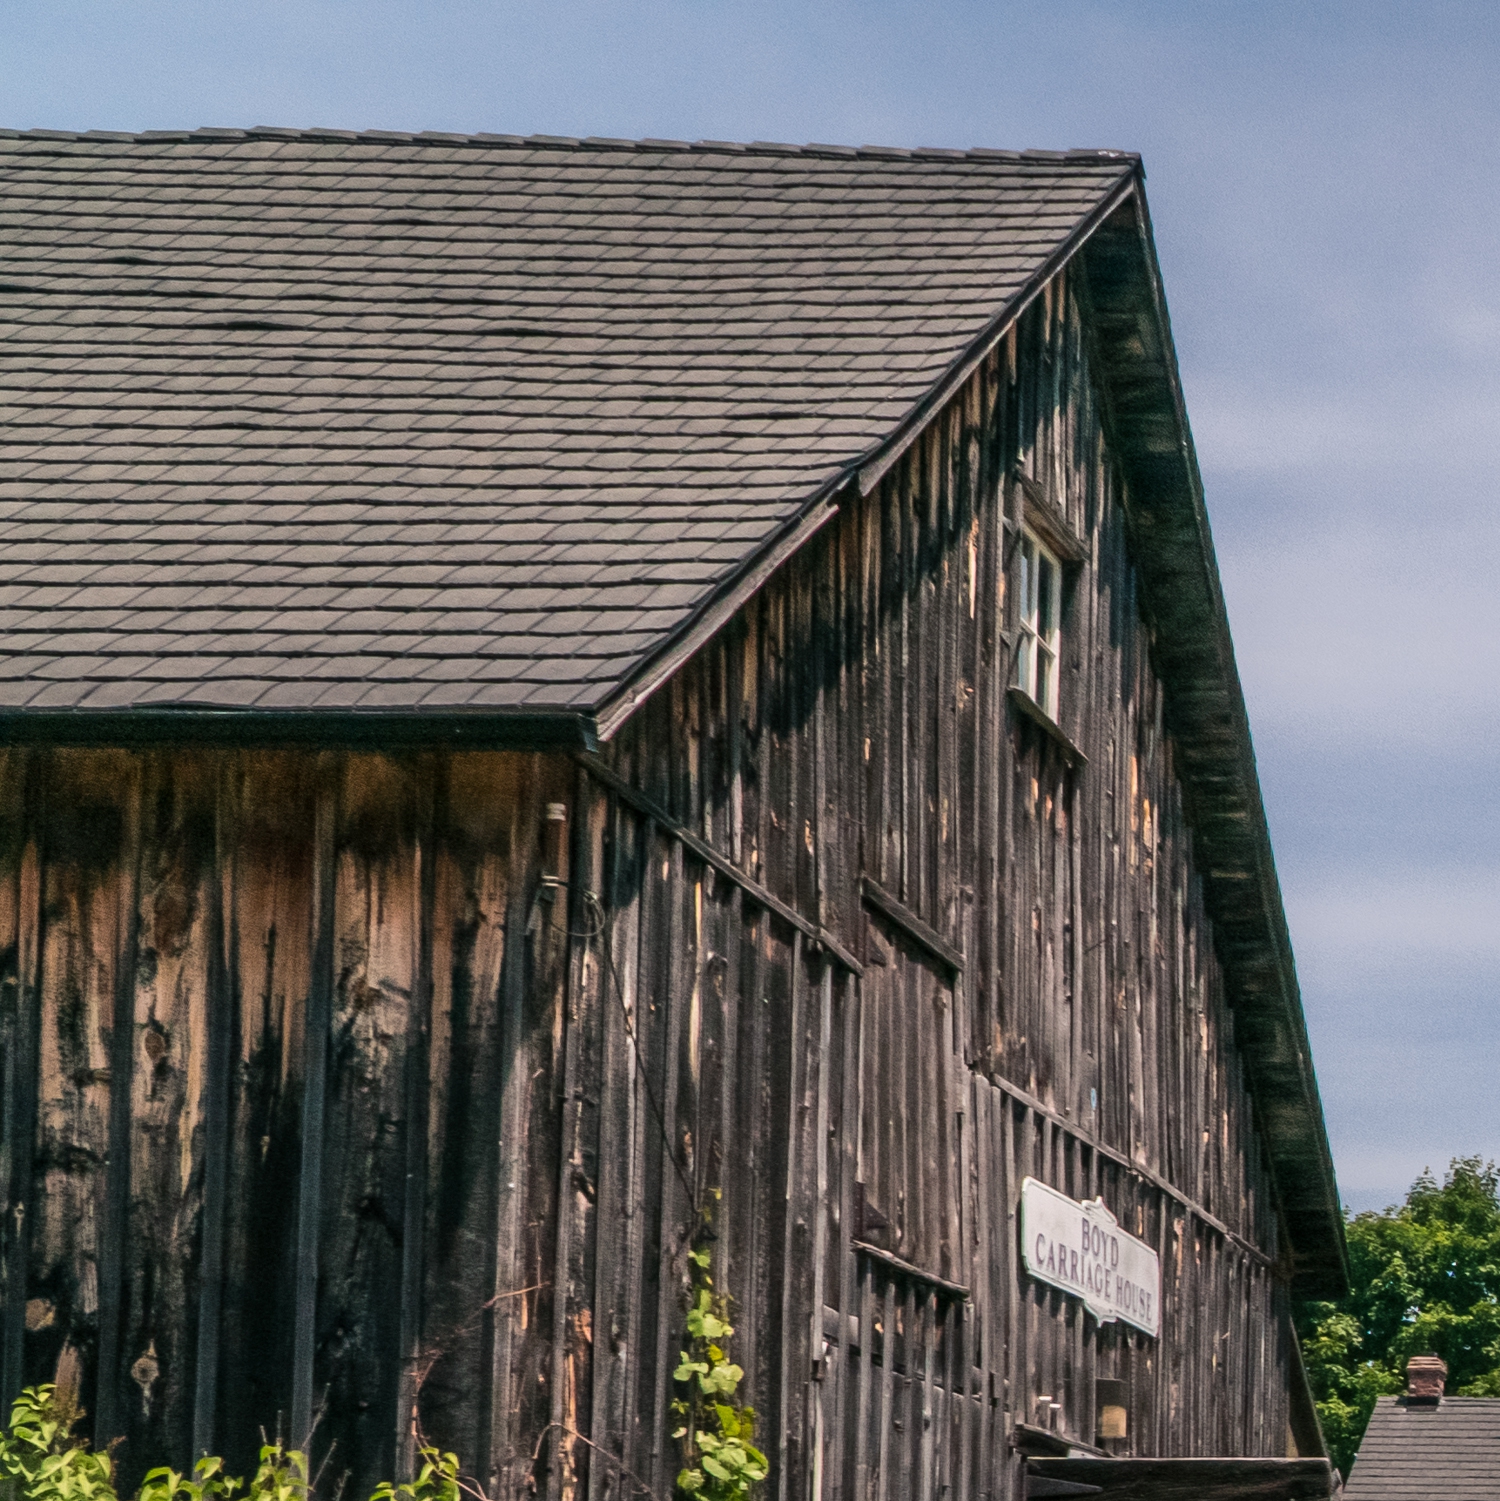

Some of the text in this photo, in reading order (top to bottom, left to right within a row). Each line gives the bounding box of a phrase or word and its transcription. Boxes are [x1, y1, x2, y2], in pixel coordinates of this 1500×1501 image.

[1035, 1232, 1153, 1323] CARRIAGE HOUSE
[1081, 1217, 1120, 1270] BOYD
